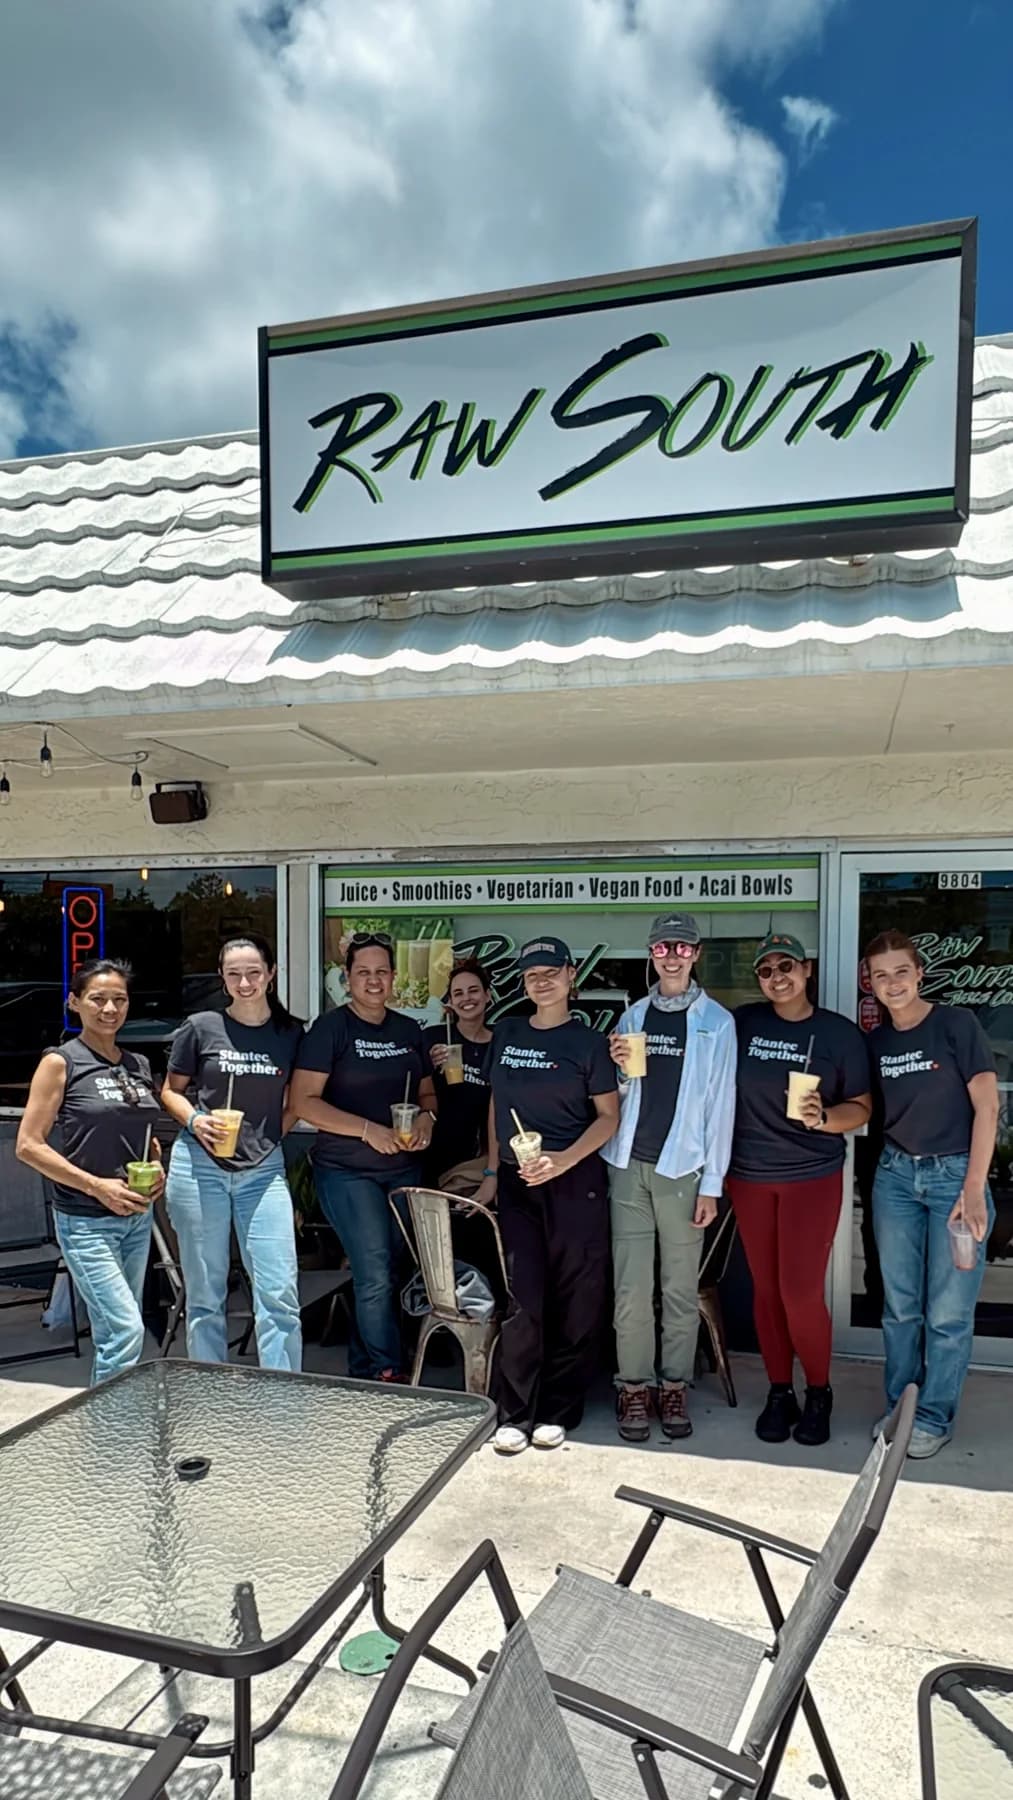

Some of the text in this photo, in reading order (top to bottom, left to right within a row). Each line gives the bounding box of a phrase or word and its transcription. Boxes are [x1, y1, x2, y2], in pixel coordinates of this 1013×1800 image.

[292, 331, 935, 514] RAW SOUTH
[340, 874, 793, 902] Juice Smoothies Vegetarian Vegan Food Acai Bowls
[940, 873, 980, 888] 9804
[69, 895, 97, 976] OP
[354, 1038, 397, 1050] Stantec
[750, 1036, 798, 1051] Stantec
[219, 1049, 270, 1062] Stantec
[503, 1045, 547, 1059] Stantec
[880, 1051, 923, 1066] Stantec
